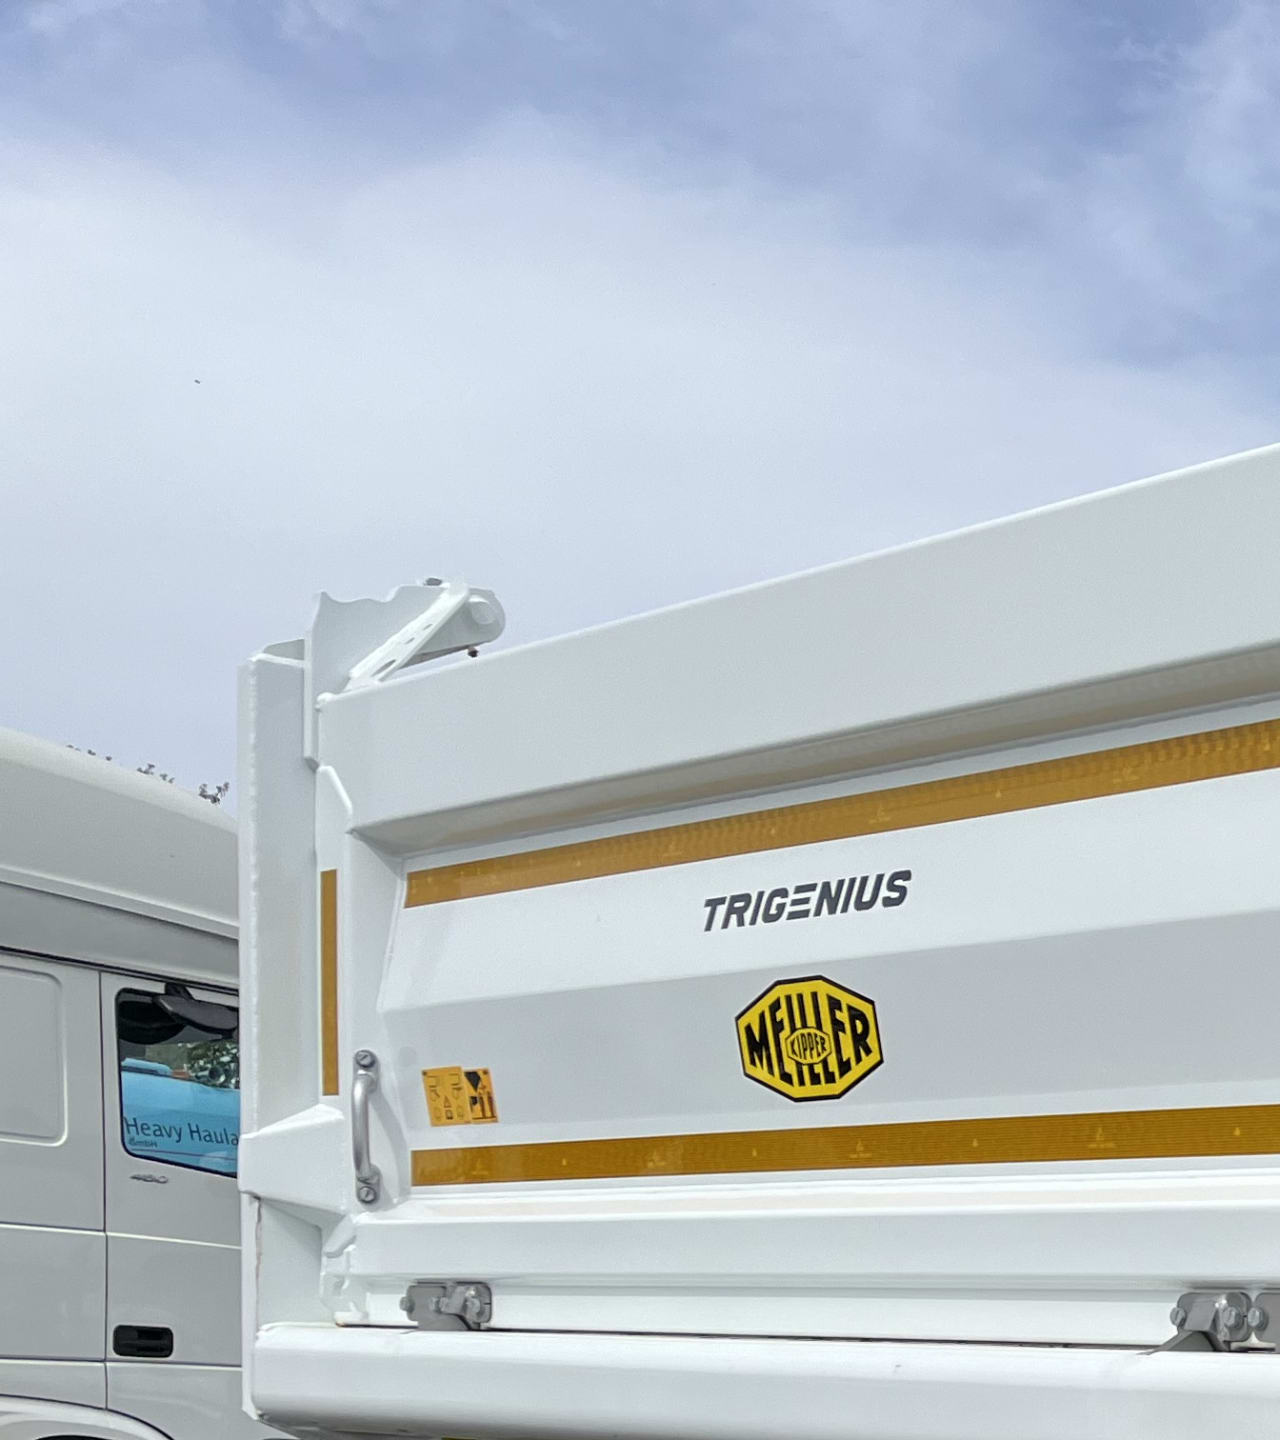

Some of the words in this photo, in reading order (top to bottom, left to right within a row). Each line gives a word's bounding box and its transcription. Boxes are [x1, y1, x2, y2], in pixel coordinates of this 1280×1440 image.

[703, 869, 912, 932] TRIGENIUS
[744, 991, 873, 1087] MEILLER
[790, 1032, 827, 1060] KIPPER
[124, 1116, 182, 1143] Heavy
